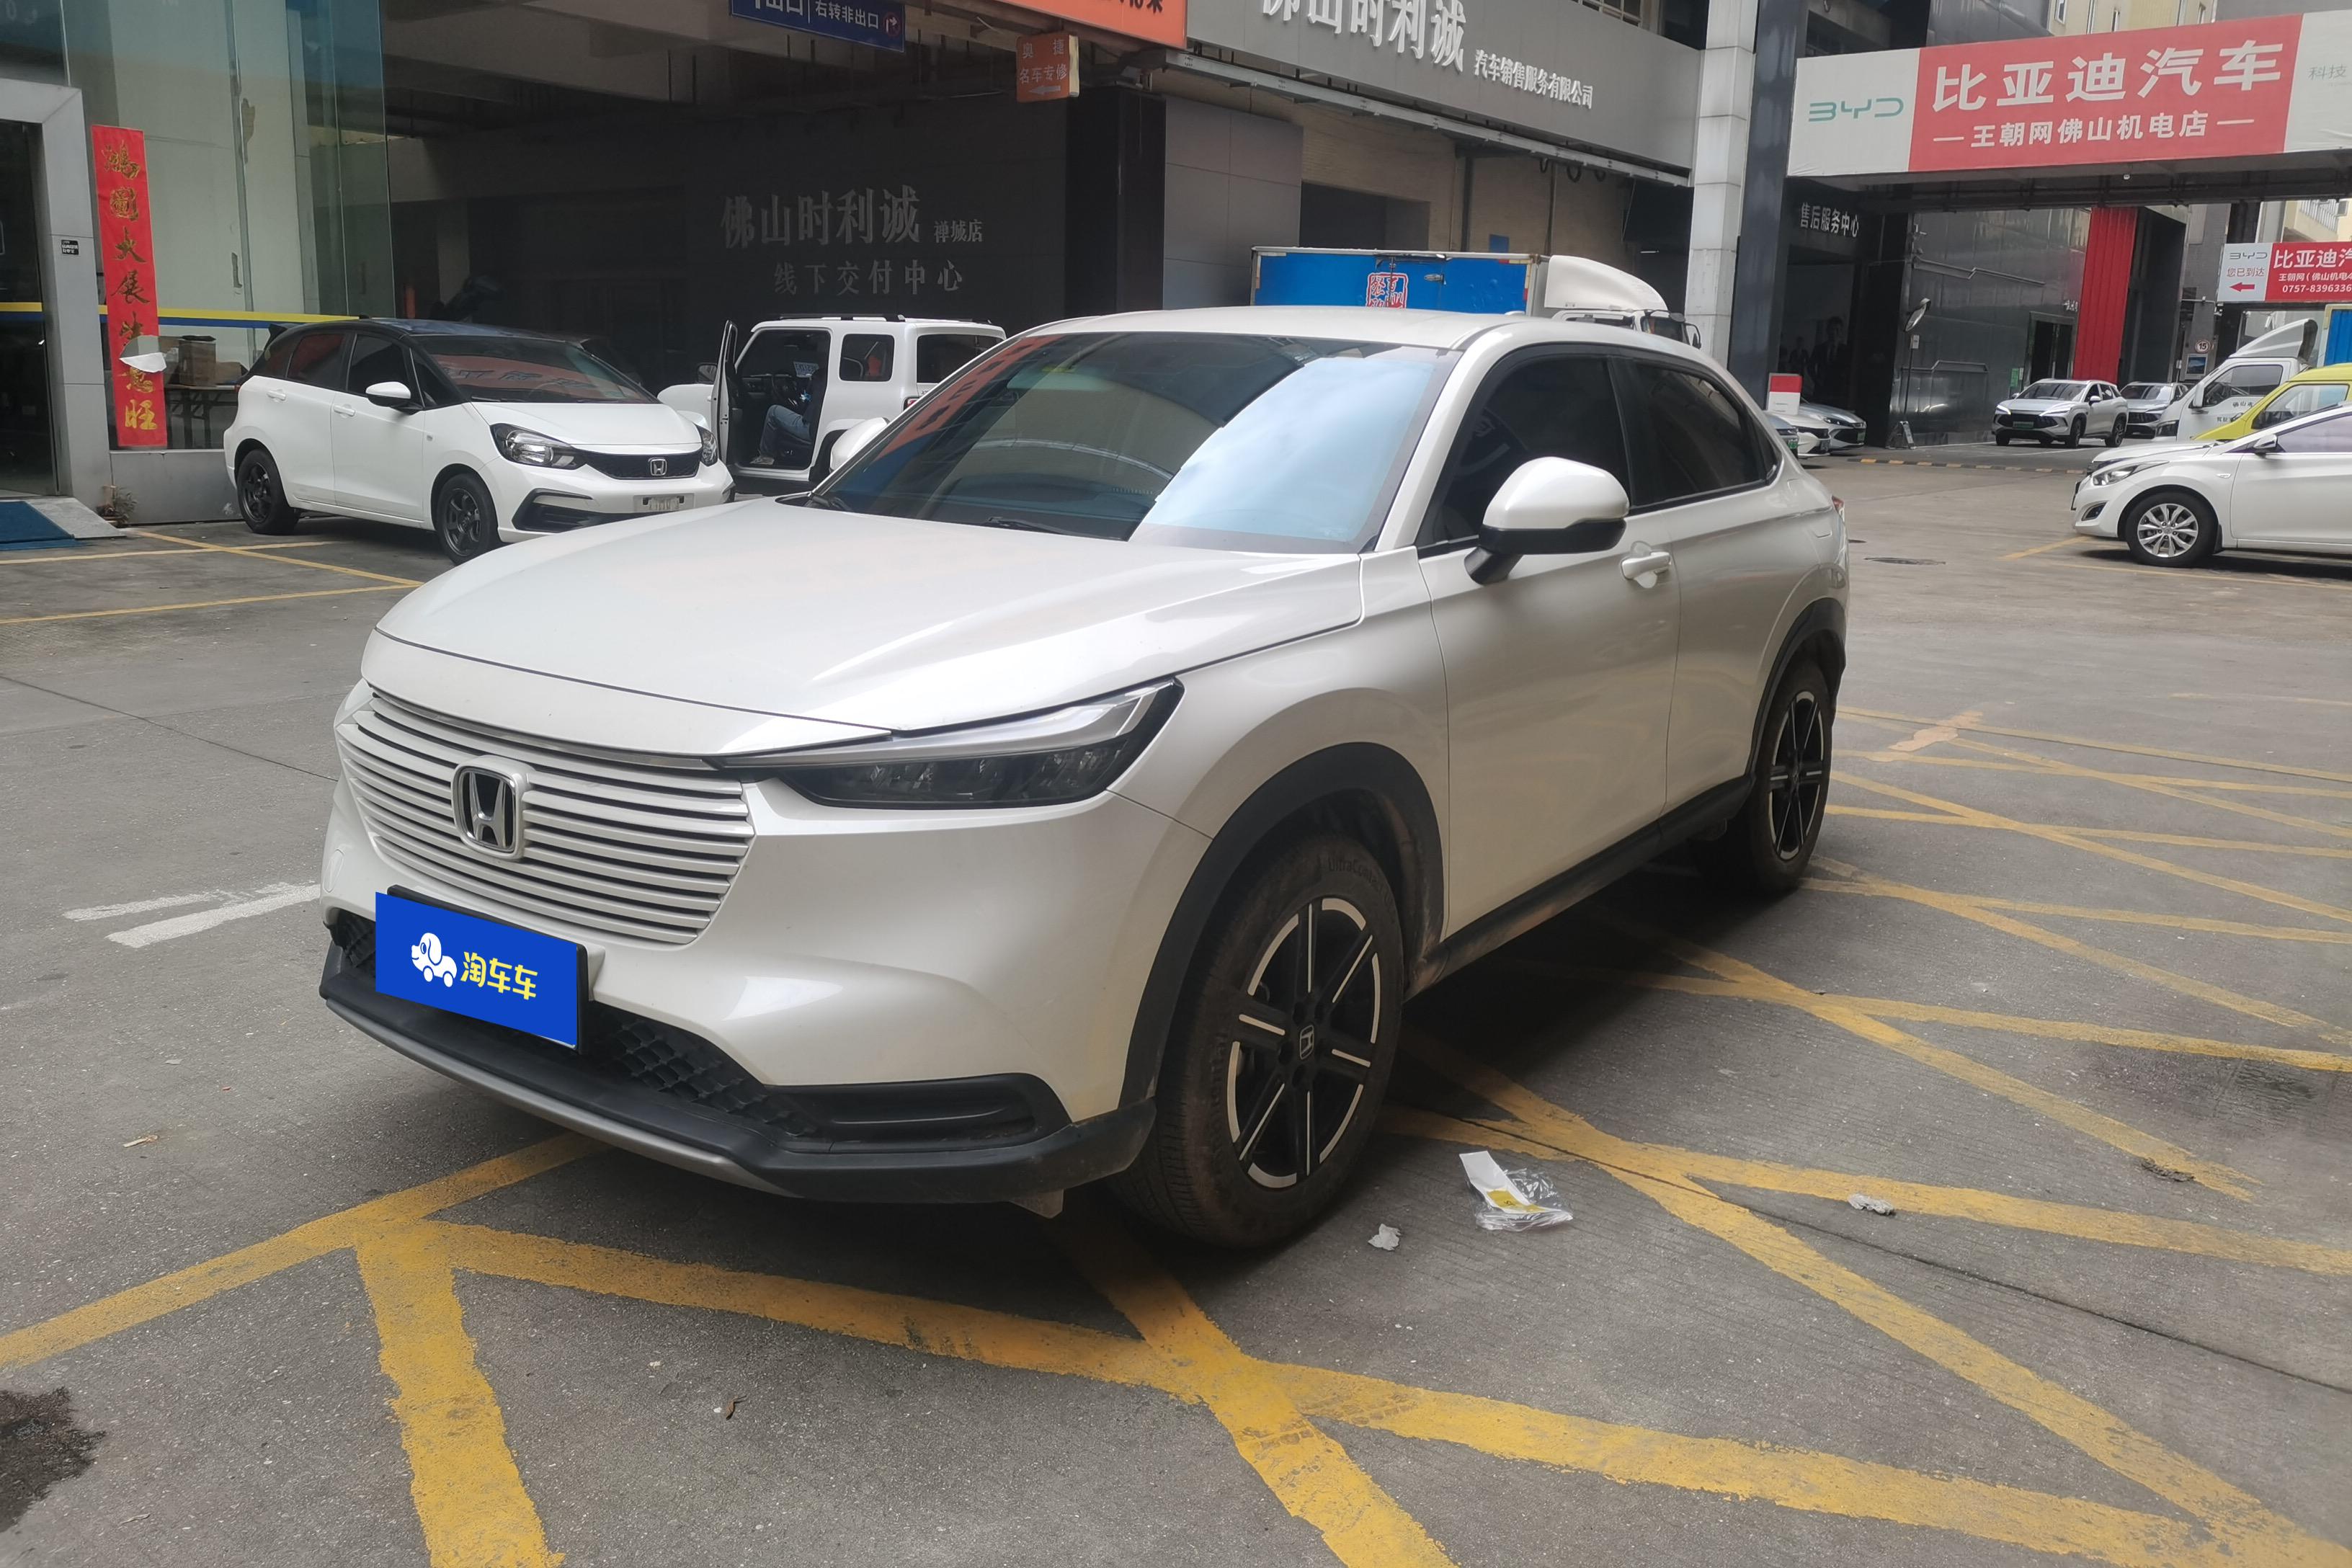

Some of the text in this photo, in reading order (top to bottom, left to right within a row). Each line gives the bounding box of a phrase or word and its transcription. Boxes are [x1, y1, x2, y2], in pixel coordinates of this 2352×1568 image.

[816, 0, 878, 30] 右转非出口
[1019, 63, 1068, 85] 名车专修
[1475, 49, 1594, 110] 汽车销售服务有限公司
[1933, 40, 2284, 113] 比亚迪汽车
[2308, 63, 2347, 81] 科技
[1808, 97, 1905, 122] BYD
[1971, 110, 2209, 148] 王朝网佛山机电店
[721, 184, 984, 248] 佛山时利诚 禅城店
[1799, 202, 1860, 239] 售后服务中心
[2229, 251, 2268, 260] BYD
[772, 258, 963, 297] 线下交付中心
[2227, 267, 2265, 277] 您已到达
[2199, 342, 2206, 350] 15
